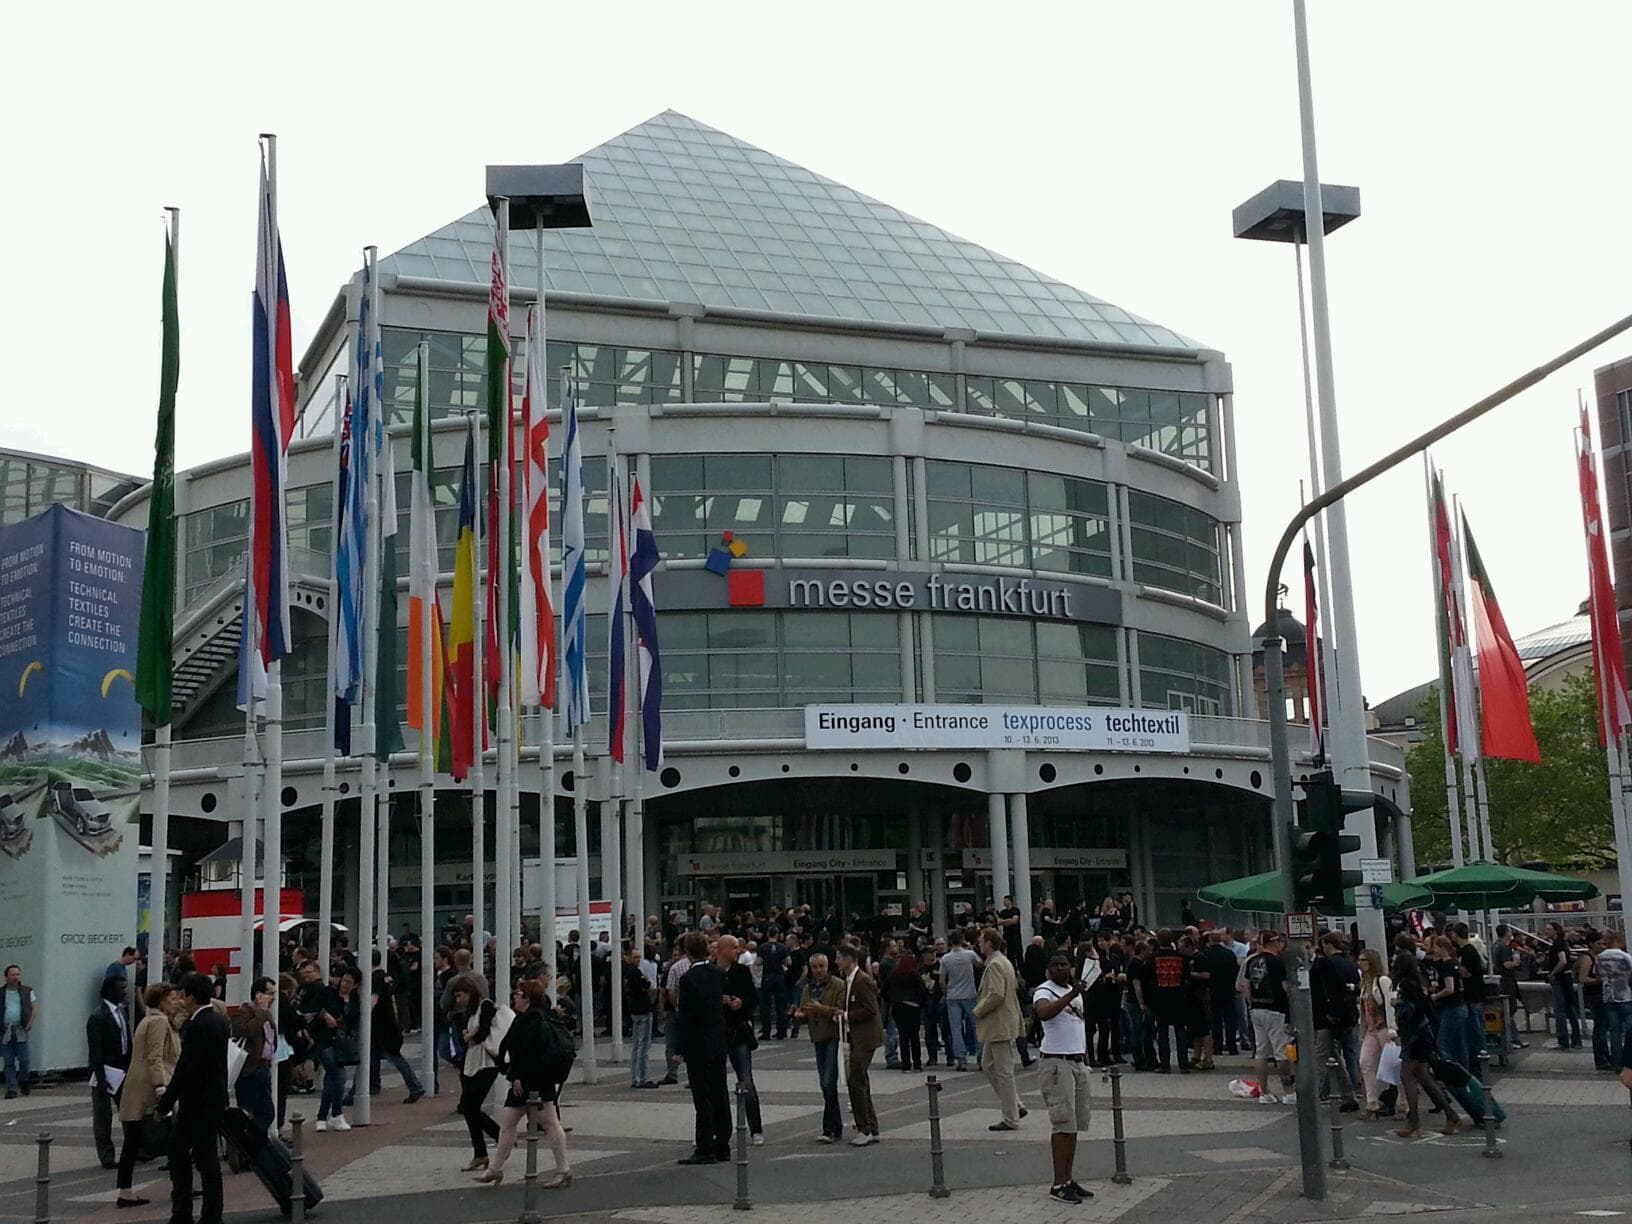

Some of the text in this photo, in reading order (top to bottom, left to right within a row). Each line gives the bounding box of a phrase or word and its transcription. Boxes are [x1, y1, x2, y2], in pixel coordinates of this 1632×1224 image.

[69, 557, 81, 572] TO
[70, 541, 132, 569] FROM MOTION
[69, 581, 118, 604] TECHNICAL
[789, 572, 1073, 617] messe frankfurt
[69, 597, 109, 618] TEXTILES
[68, 614, 121, 637] CREATE THE
[68, 631, 126, 654] CONNECTION
[818, 712, 896, 733] Eingang
[913, 711, 988, 729] Entrance
[1003, 711, 1092, 734] texprocess
[1105, 713, 1180, 735] techtextil
[1043, 735, 1060, 745] 2013
[793, 859, 827, 869] Eingang
[829, 858, 846, 868] City
[61, 933, 125, 945] GROZ BECKERT
